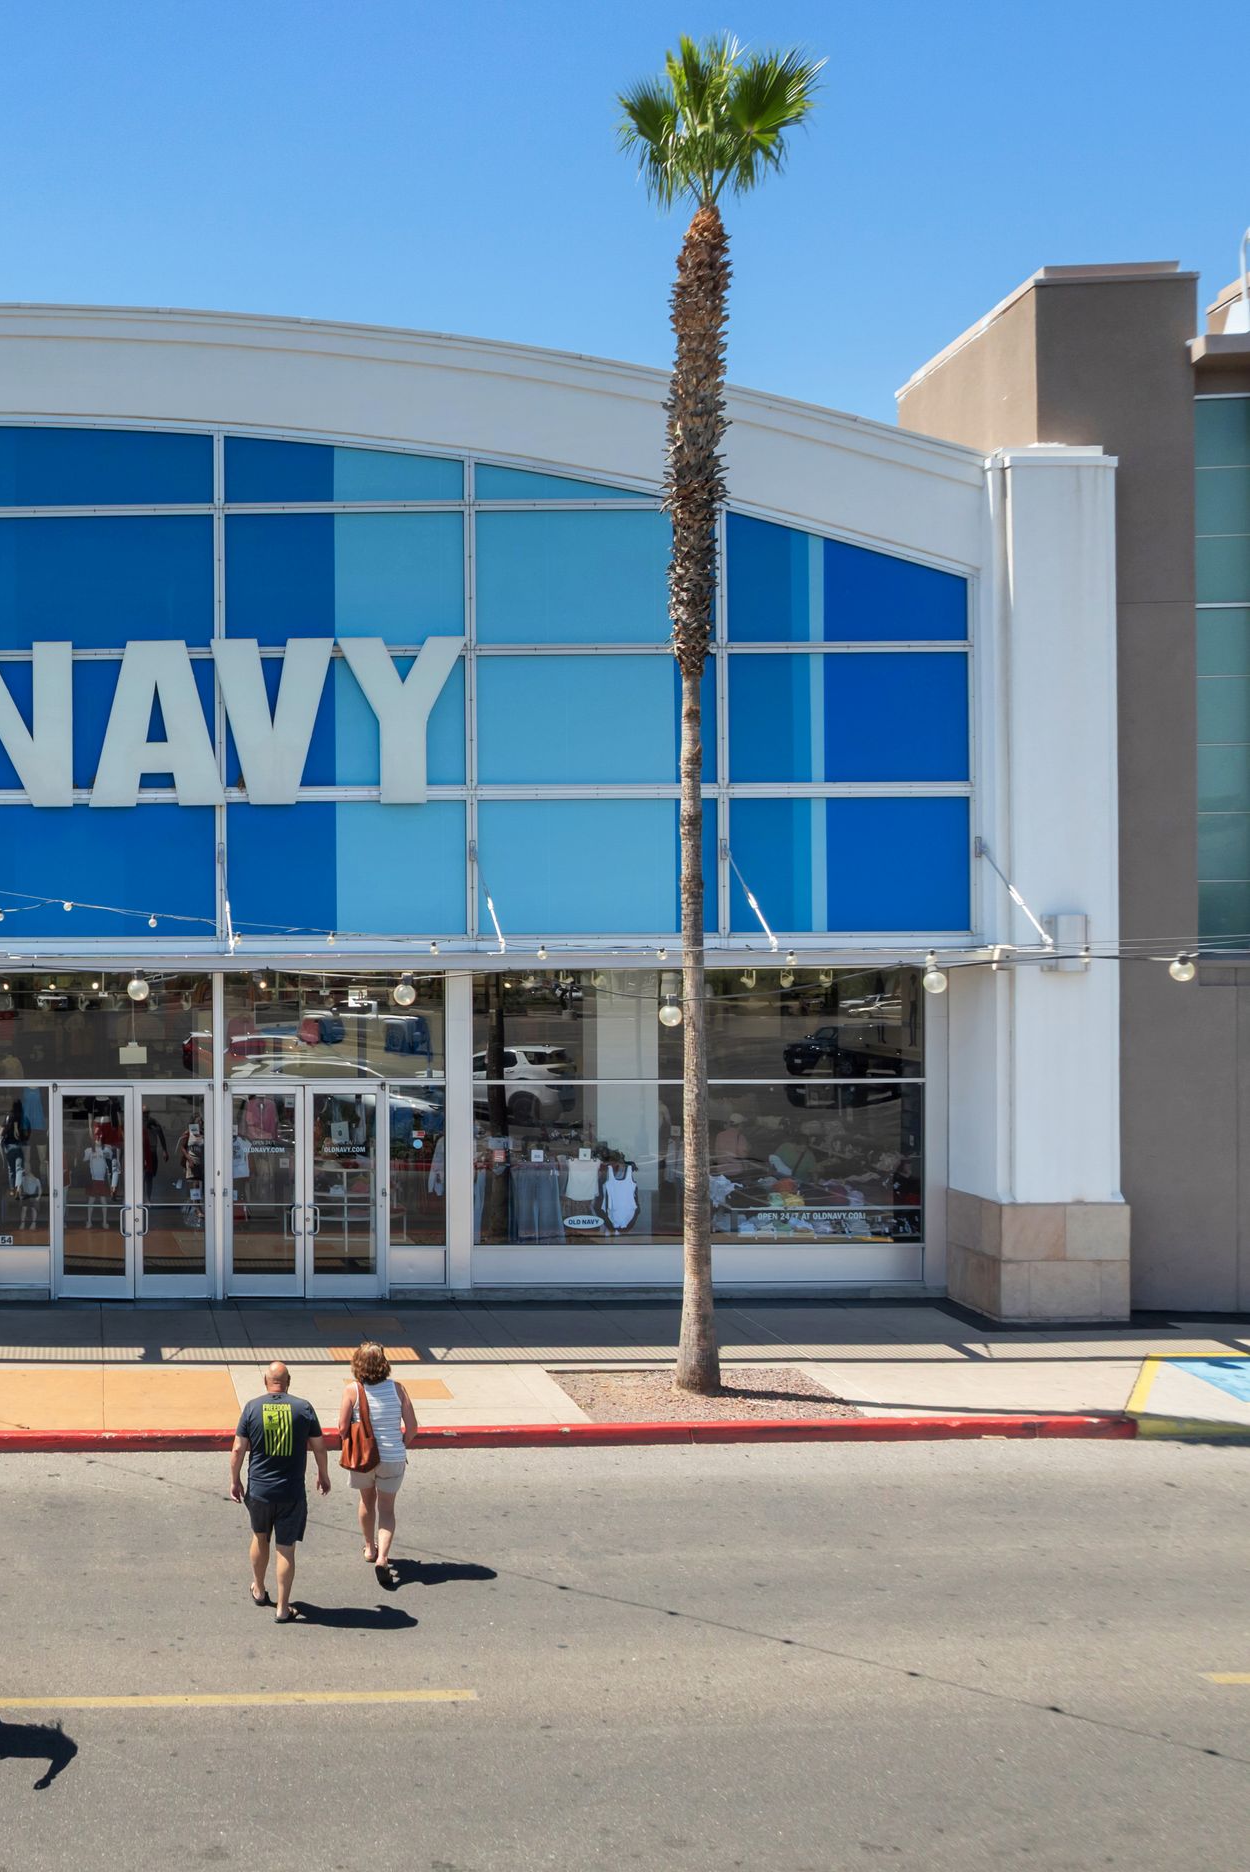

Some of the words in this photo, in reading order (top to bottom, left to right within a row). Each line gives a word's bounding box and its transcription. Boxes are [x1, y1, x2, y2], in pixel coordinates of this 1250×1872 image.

[757, 1212, 778, 1220] OPEN
[801, 1212, 811, 1220] AT
[813, 1212, 866, 1220] OLDNAVY.COM
